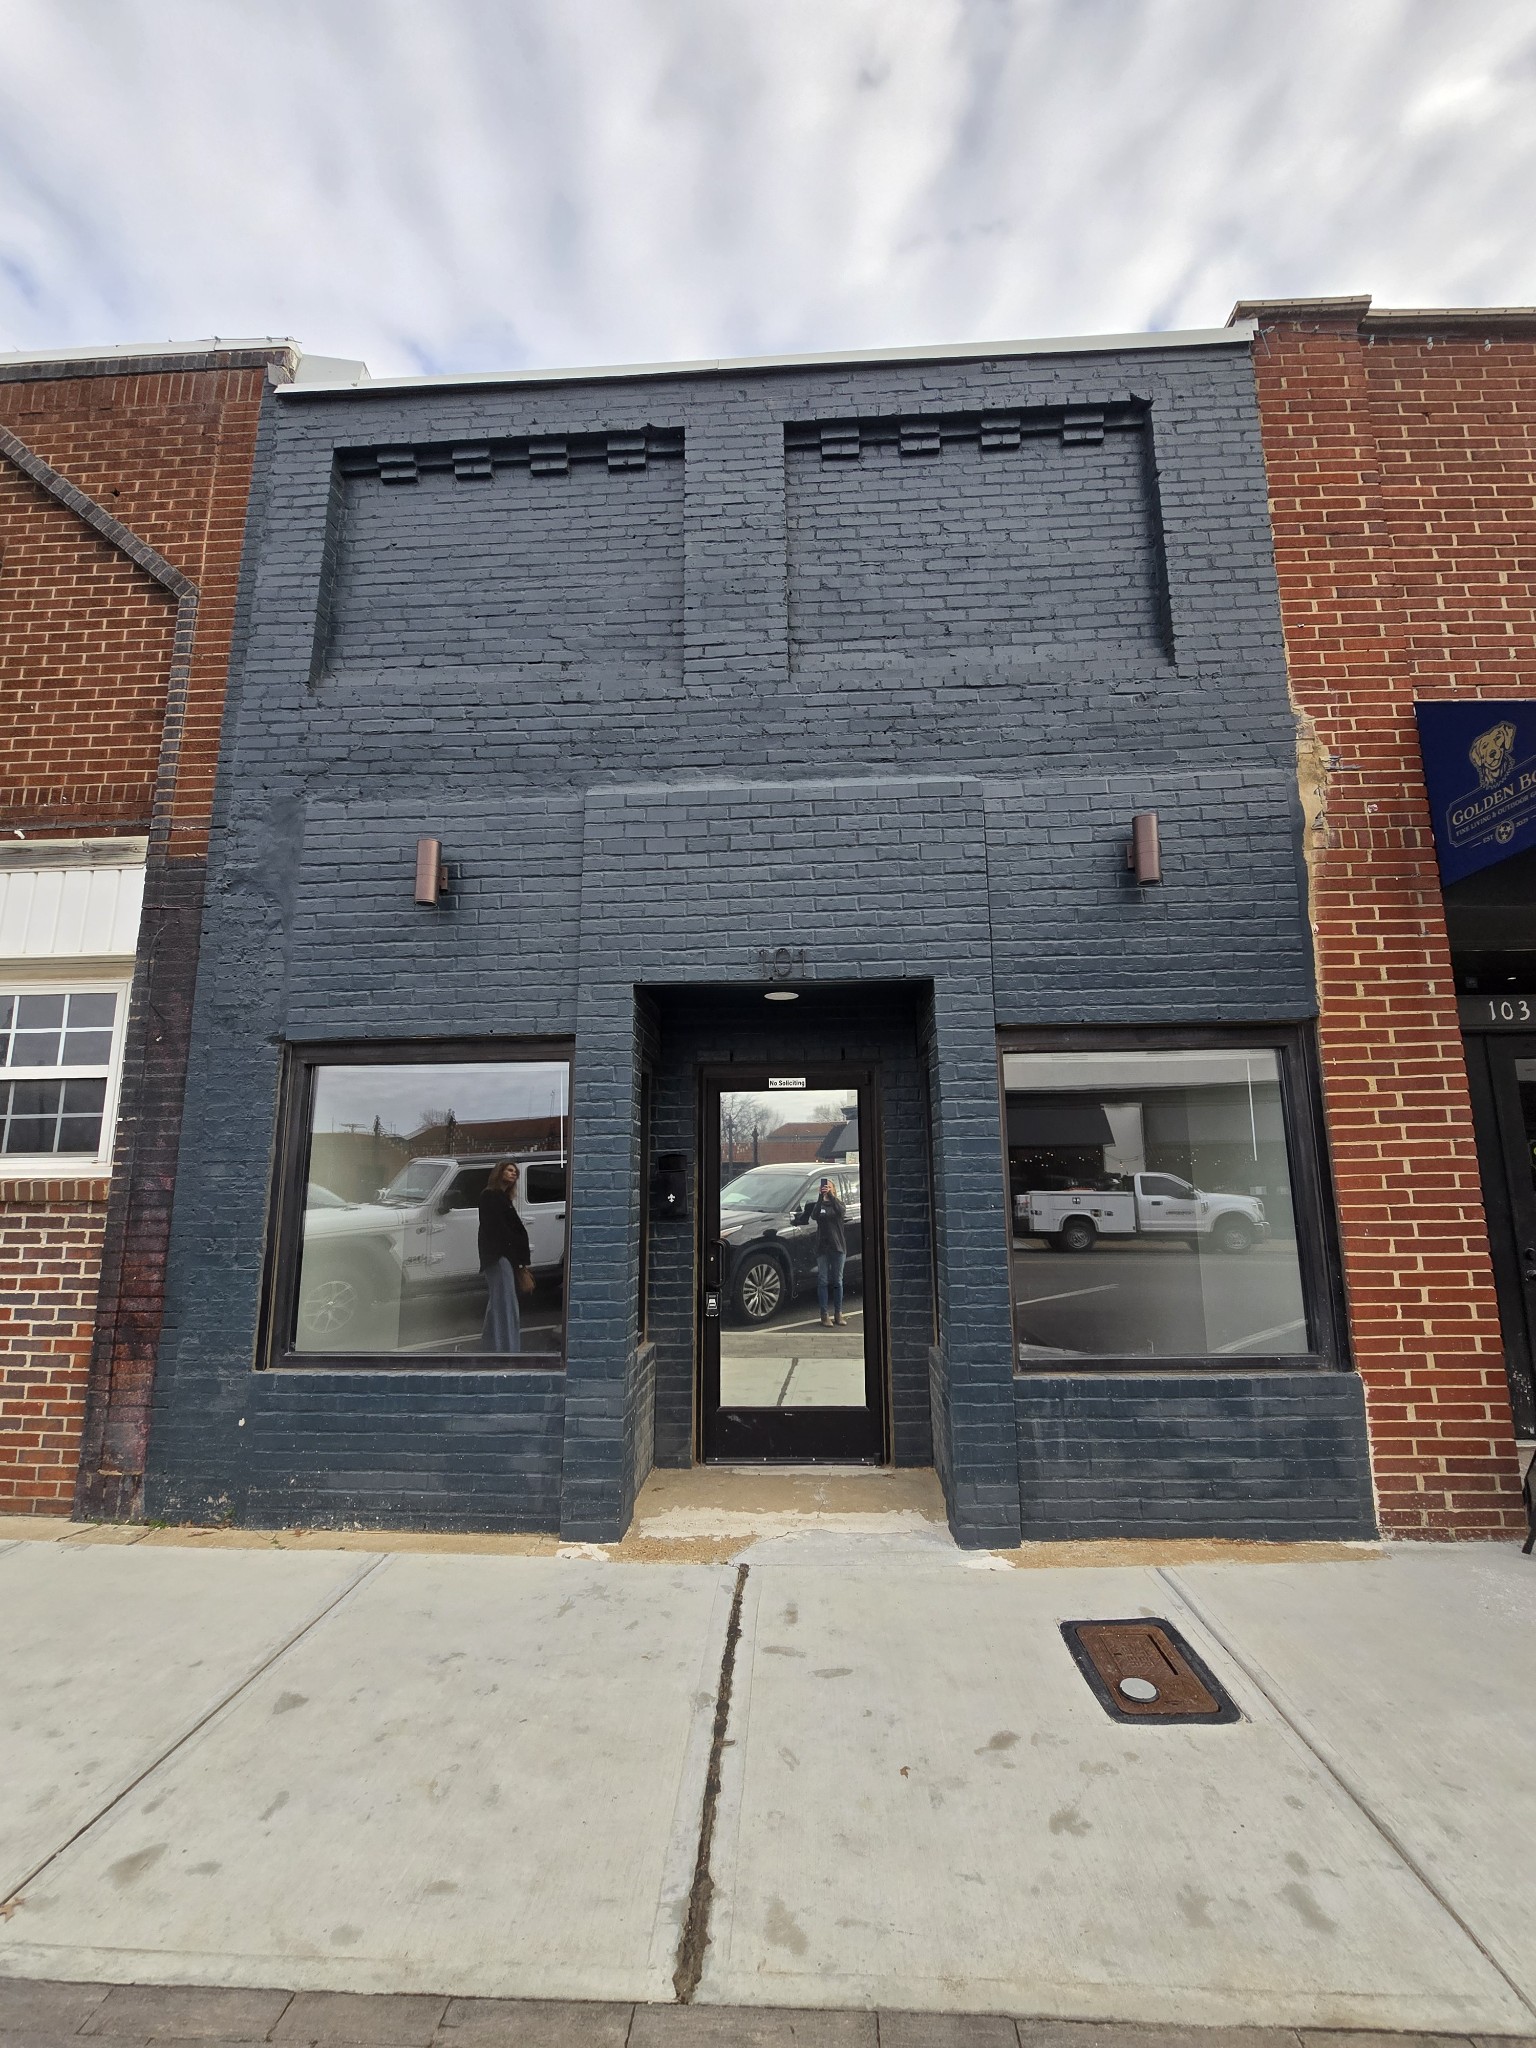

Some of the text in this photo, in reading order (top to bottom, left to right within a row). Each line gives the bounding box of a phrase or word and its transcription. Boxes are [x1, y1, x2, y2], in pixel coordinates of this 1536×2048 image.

[1452, 783, 1514, 825] GOLDEN
[1456, 825, 1470, 837] FINE
[1471, 815, 1492, 829] LIVING
[1497, 795, 1529, 815] OUTDOOR
[1482, 834, 1494, 844] EST
[758, 947, 806, 978] 101
[1488, 1000, 1531, 1021] 103
[778, 1080, 805, 1088] Soliciting
